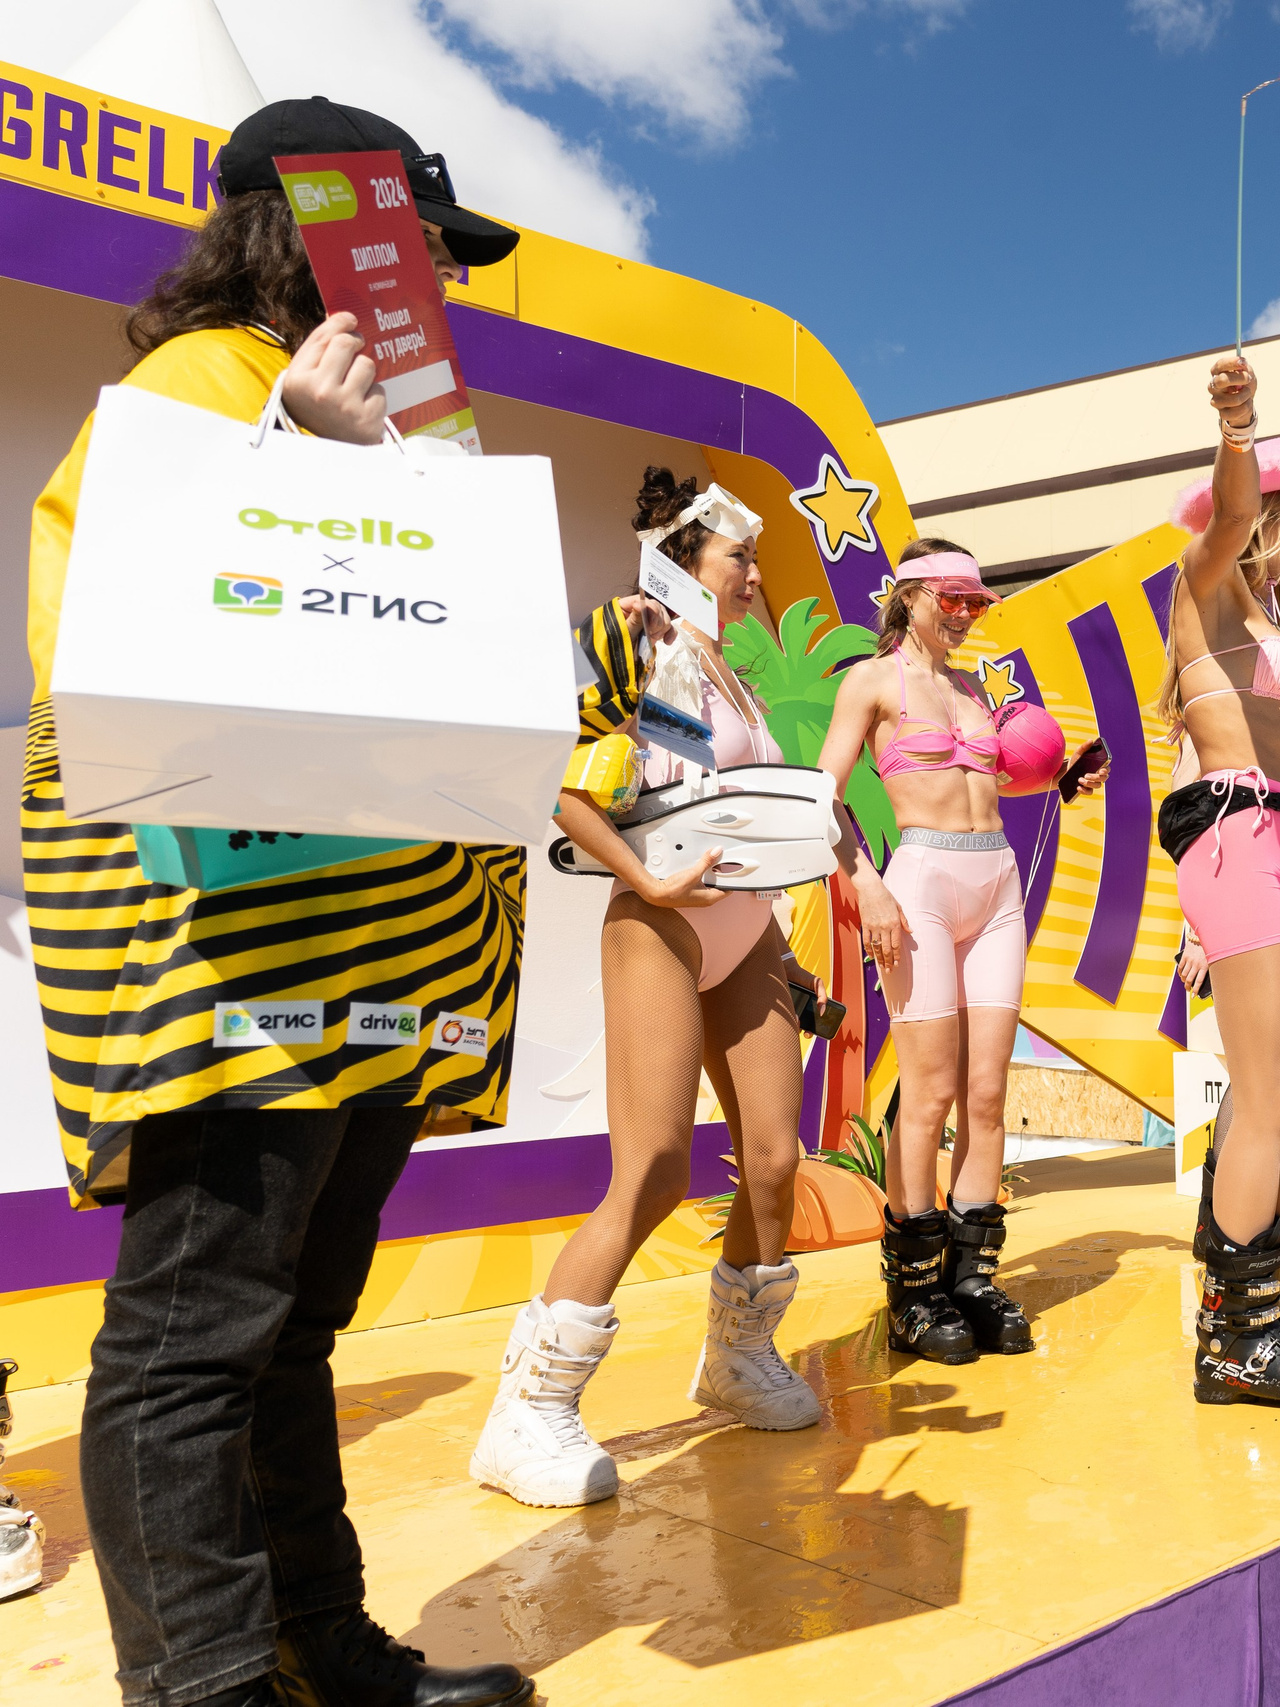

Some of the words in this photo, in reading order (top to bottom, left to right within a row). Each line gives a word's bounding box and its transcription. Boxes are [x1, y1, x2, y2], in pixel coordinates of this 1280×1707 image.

[370, 176, 408, 210] 2024
[351, 241, 400, 272] ДИПЛОМ
[374, 308, 411, 332] Вошел
[382, 339, 396, 364] ту
[395, 324, 427, 359] дверь!
[301, 588, 448, 625] 2ГИС
[258, 1013, 316, 1030] 2ГИС
[360, 1013, 416, 1034] drivee
